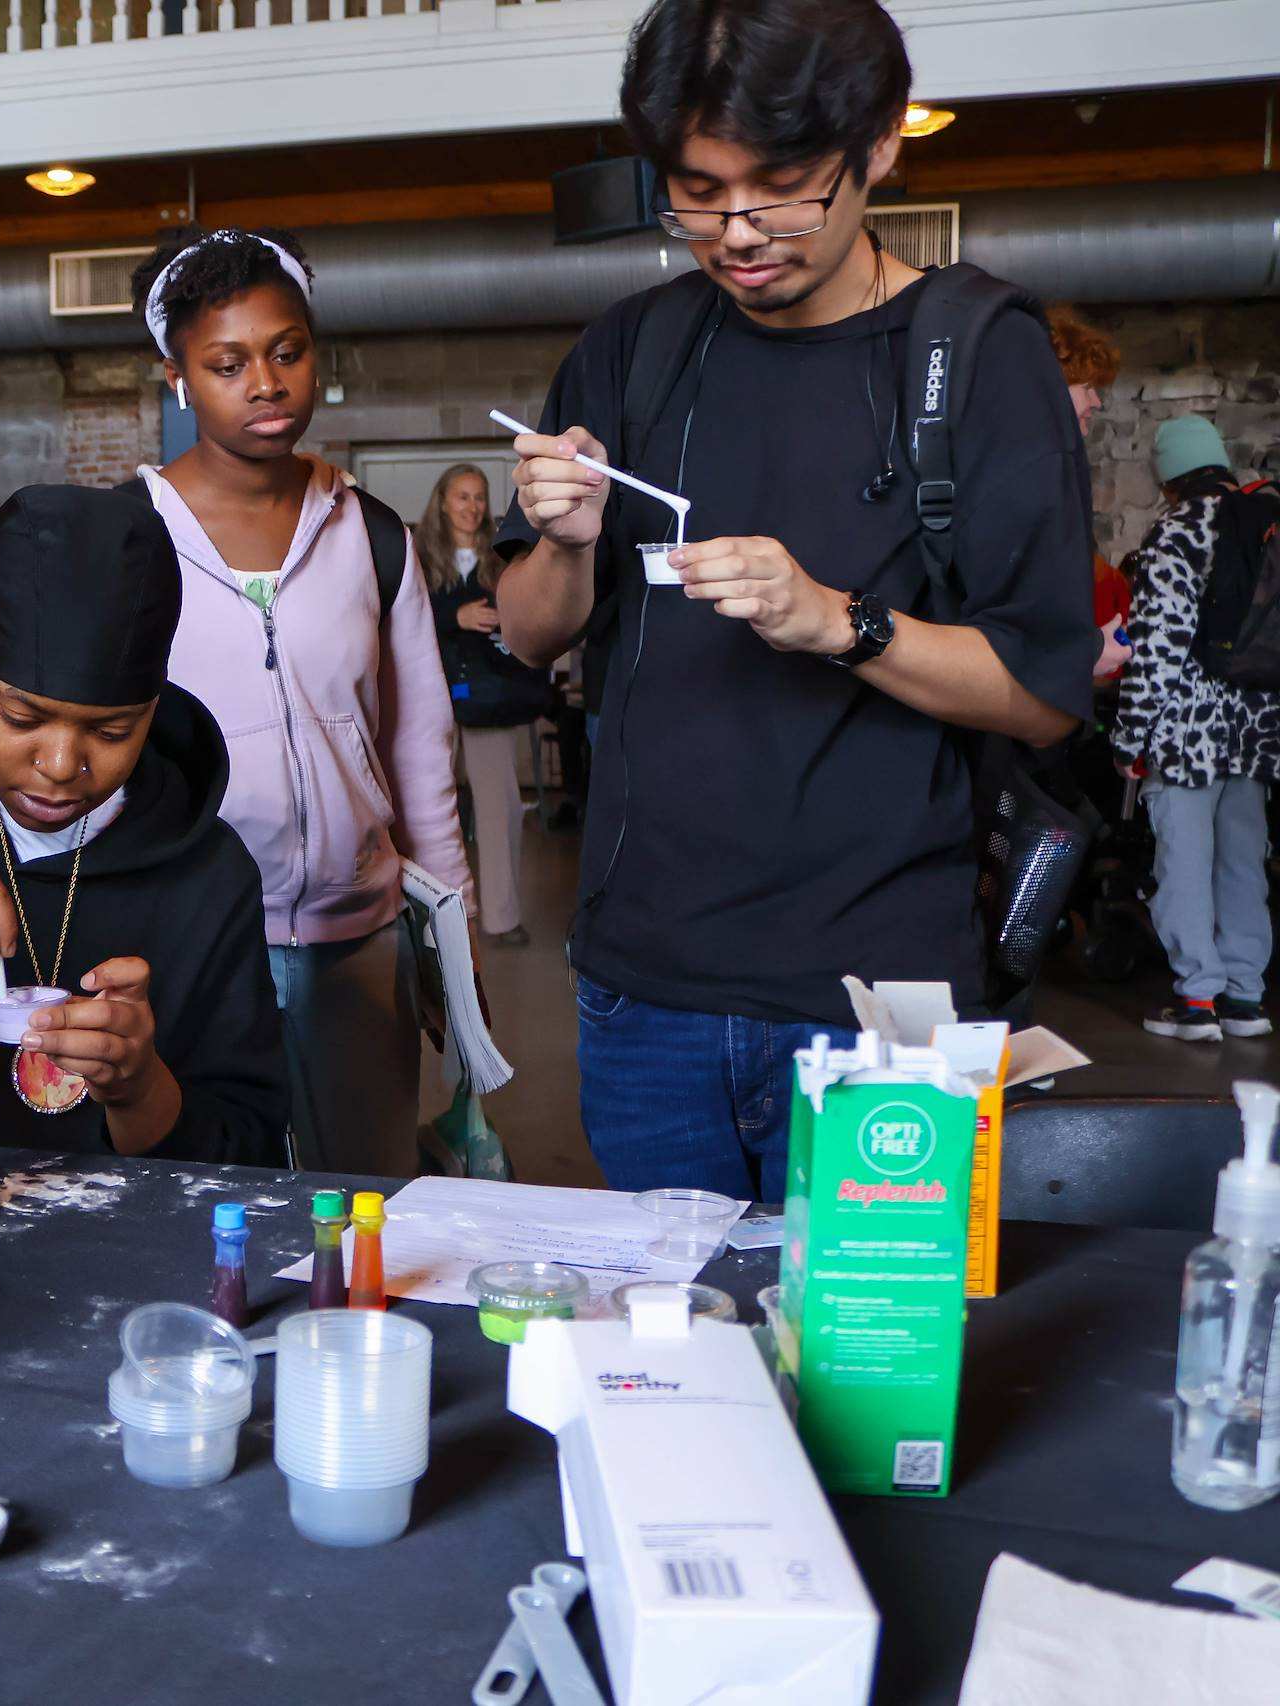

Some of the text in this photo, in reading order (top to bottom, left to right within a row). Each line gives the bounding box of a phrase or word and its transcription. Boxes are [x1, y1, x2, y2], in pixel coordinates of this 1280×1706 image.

[924, 348, 944, 412] adidas
[870, 1140, 921, 1156] FREE
[837, 1179, 948, 1208] Replenish
[597, 1372, 648, 1382] deal
